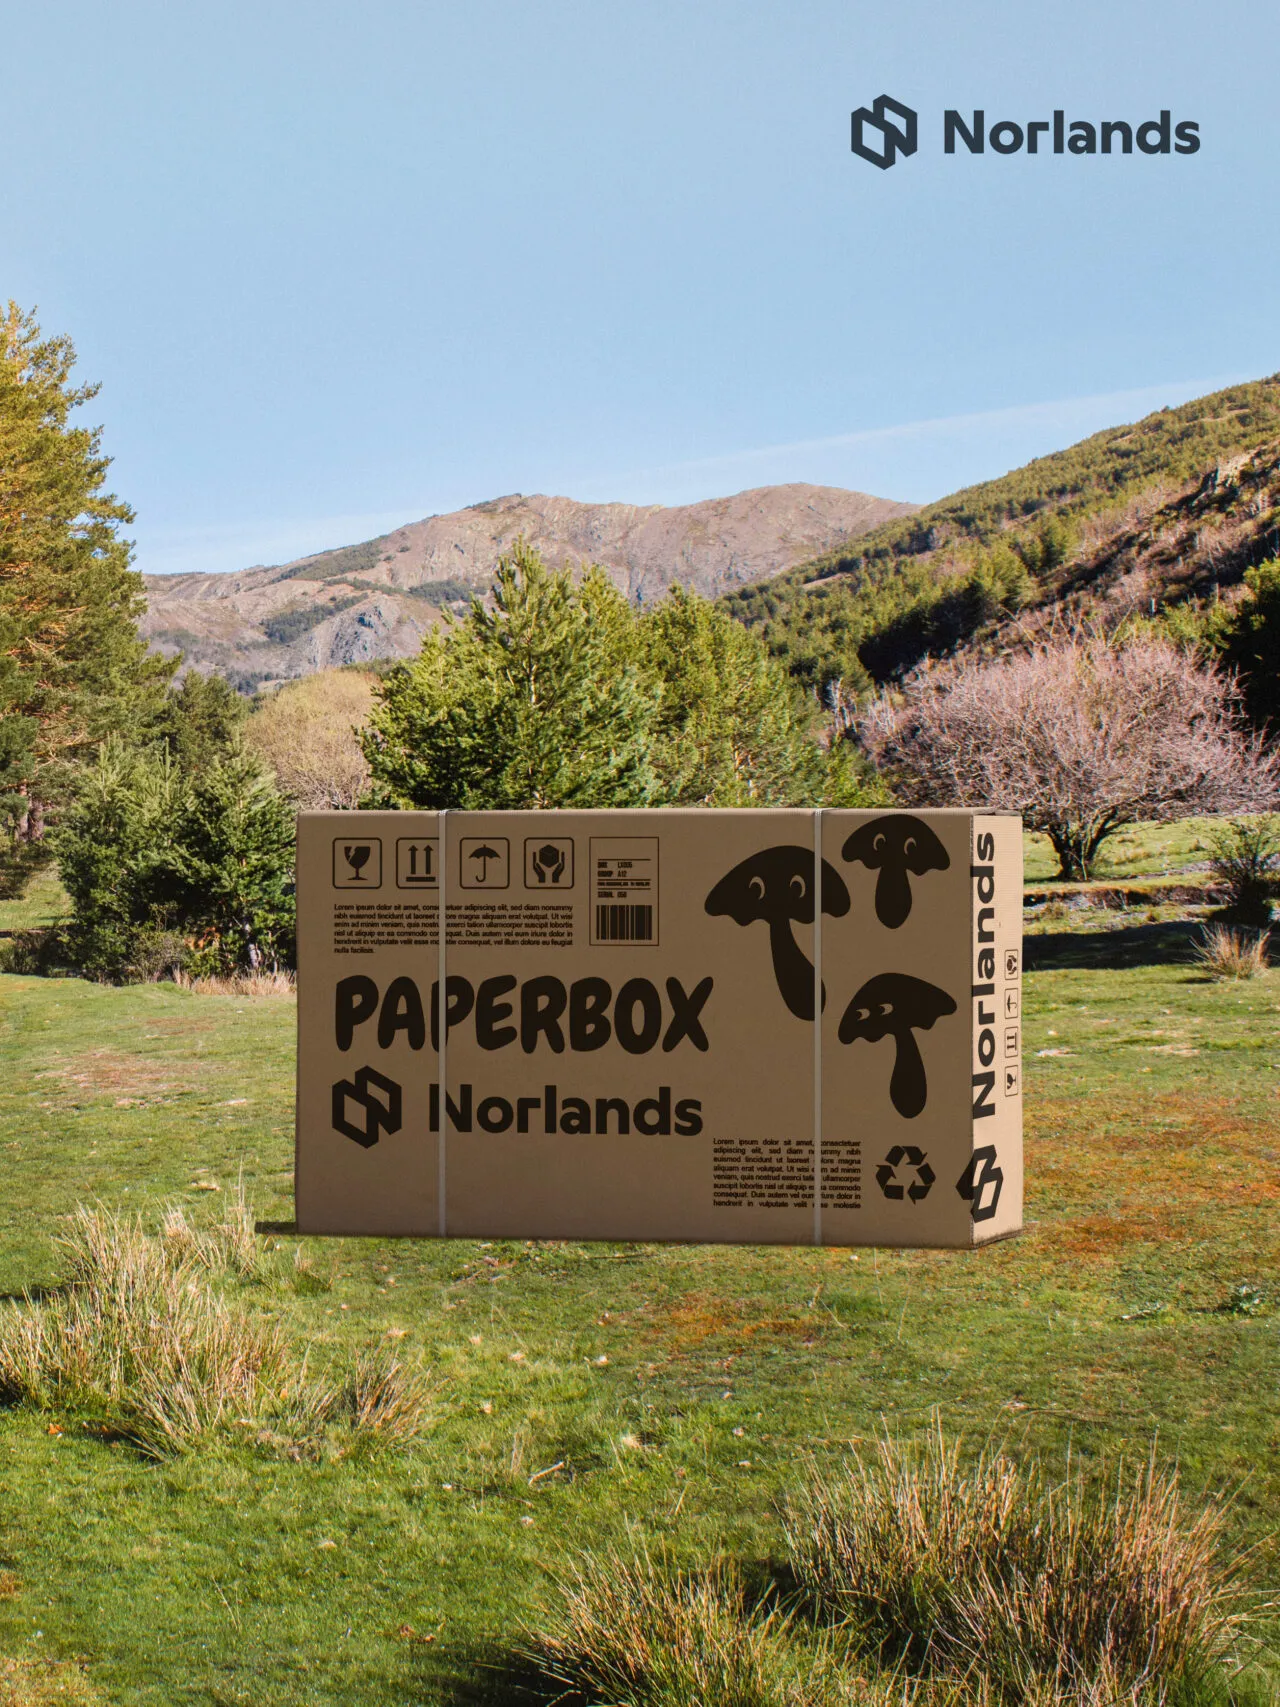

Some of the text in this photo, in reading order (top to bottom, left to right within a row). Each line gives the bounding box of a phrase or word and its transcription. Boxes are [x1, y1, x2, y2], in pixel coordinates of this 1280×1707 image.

[335, 974, 714, 1055] PAPERBOX
[971, 832, 995, 1119] Norlands
[429, 1083, 704, 1137] Norlands
